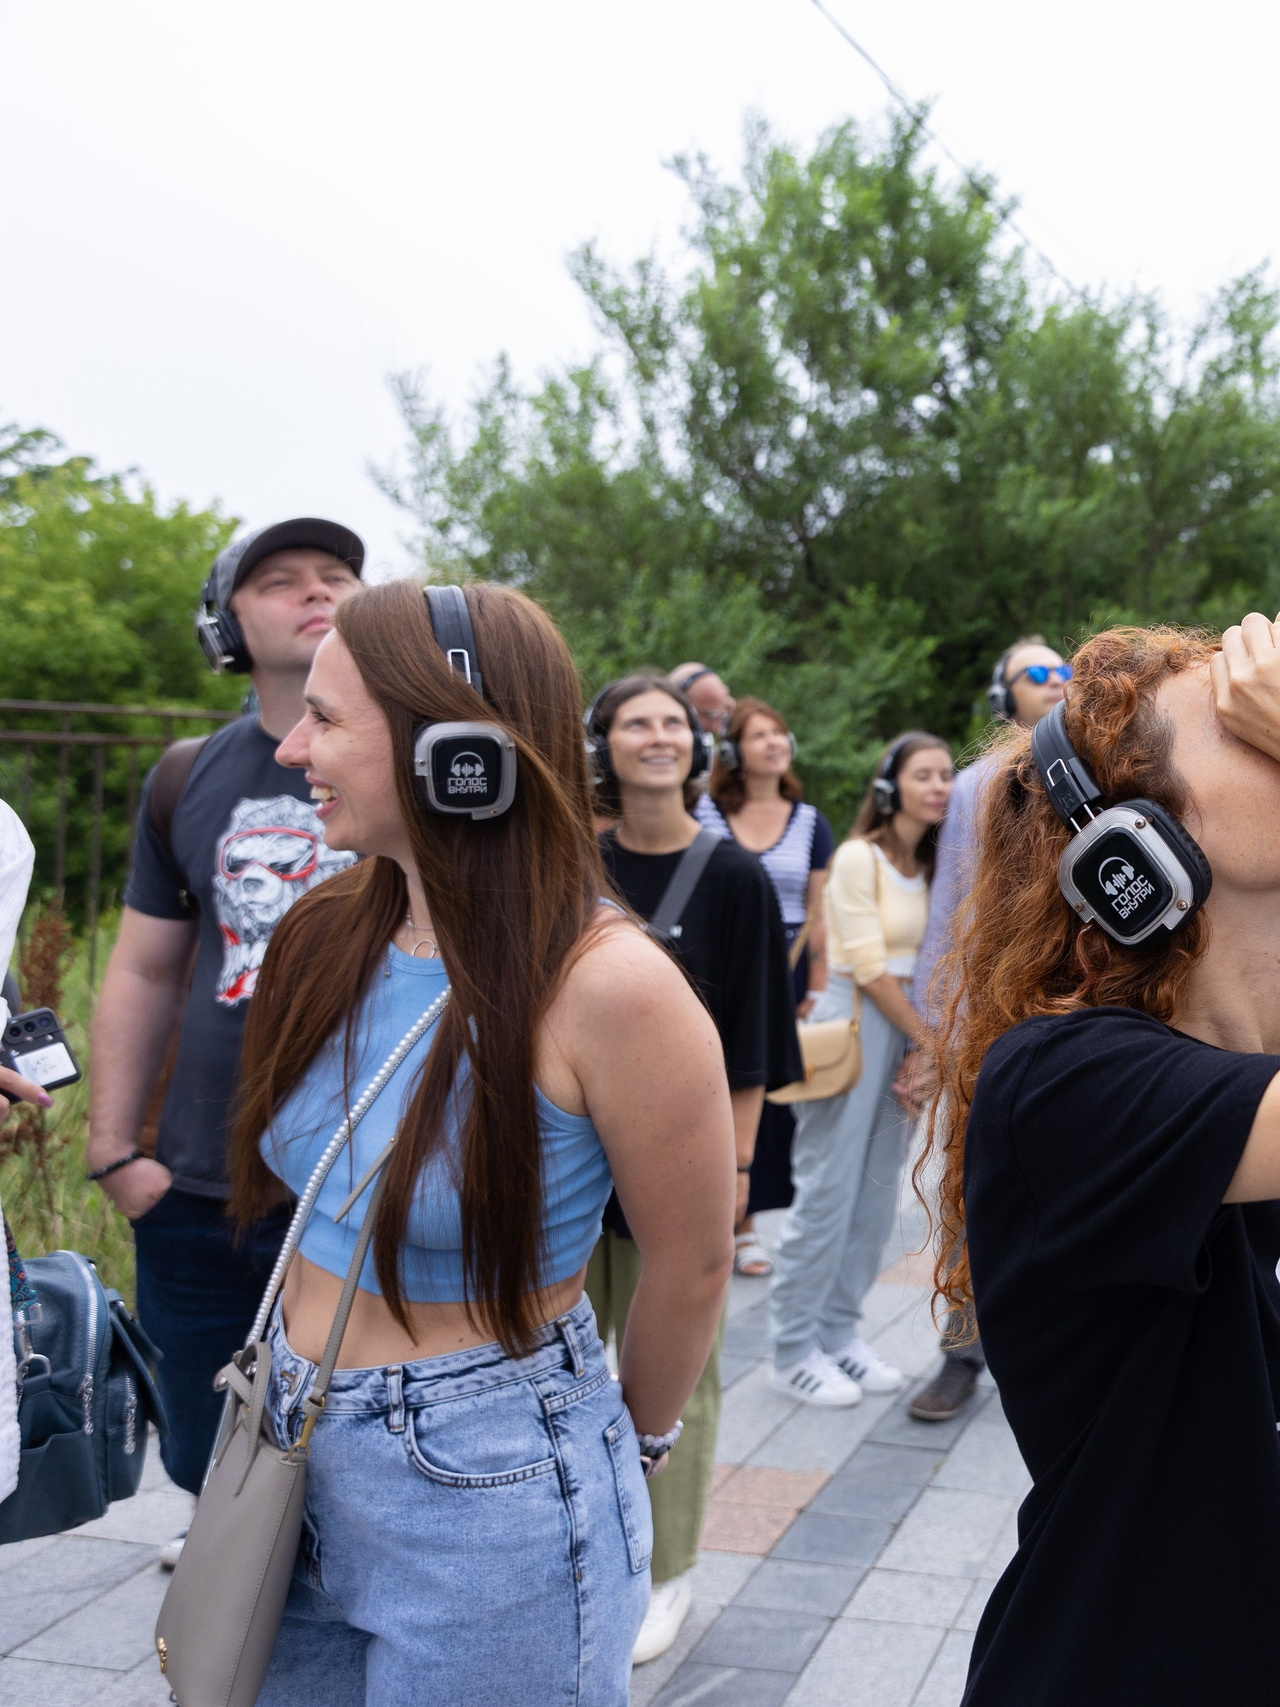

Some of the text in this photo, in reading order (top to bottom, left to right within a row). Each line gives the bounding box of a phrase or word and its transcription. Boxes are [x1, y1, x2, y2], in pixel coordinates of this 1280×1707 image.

[448, 777, 488, 786] ГОЛОС
[448, 786, 488, 794] ВНУТРИ
[1111, 874, 1149, 912] ГОЛОС
[1118, 884, 1155, 919] ВНУТРИ
